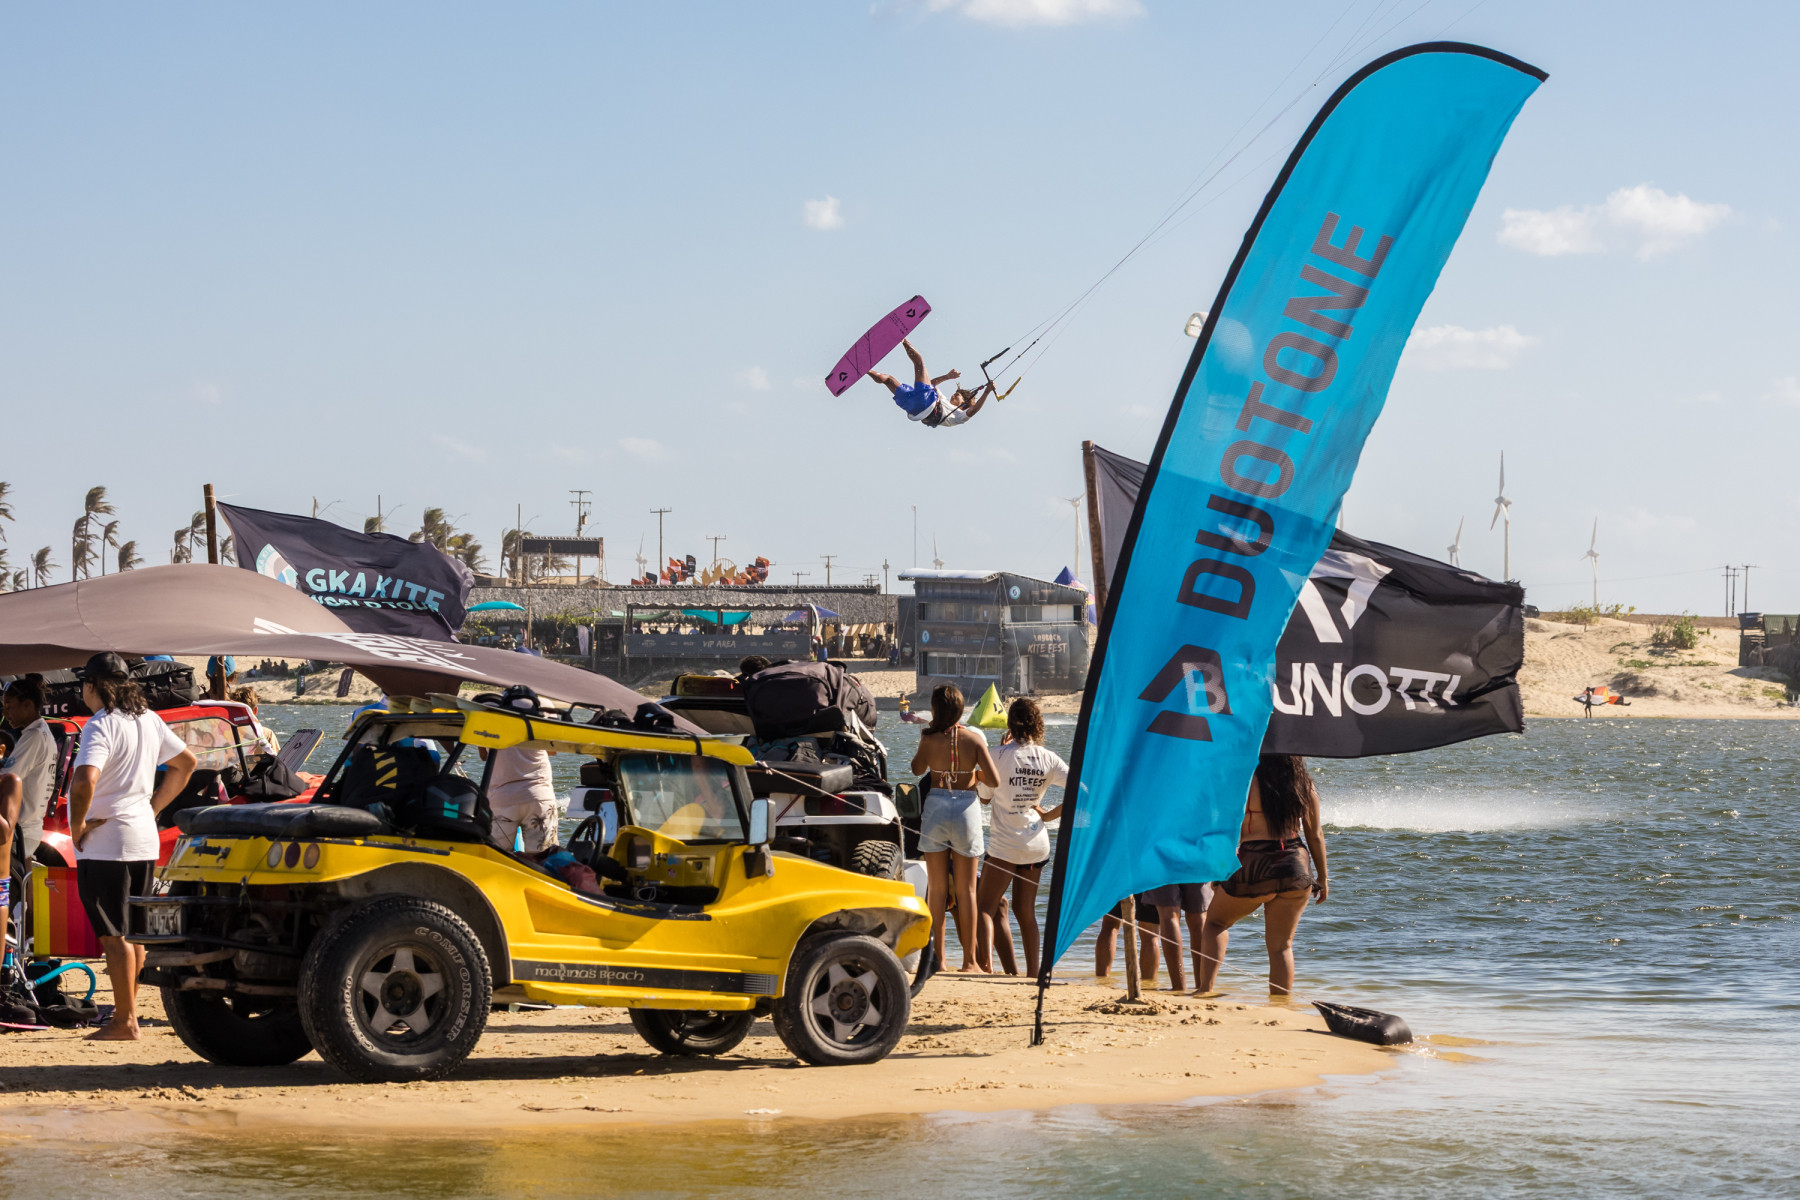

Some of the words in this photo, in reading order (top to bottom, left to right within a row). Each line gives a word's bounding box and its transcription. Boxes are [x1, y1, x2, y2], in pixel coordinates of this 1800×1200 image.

[1177, 211, 1394, 620] DUOTONE
[305, 568, 366, 597] GKA
[370, 574, 445, 609] KITE
[702, 640, 714, 648] VIP
[716, 640, 736, 648] AREA
[1027, 643, 1046, 654] KITE
[1047, 643, 1067, 654] FEST
[1182, 662, 1461, 718] BUNOTTI
[414, 926, 472, 1042] COMFORSER
